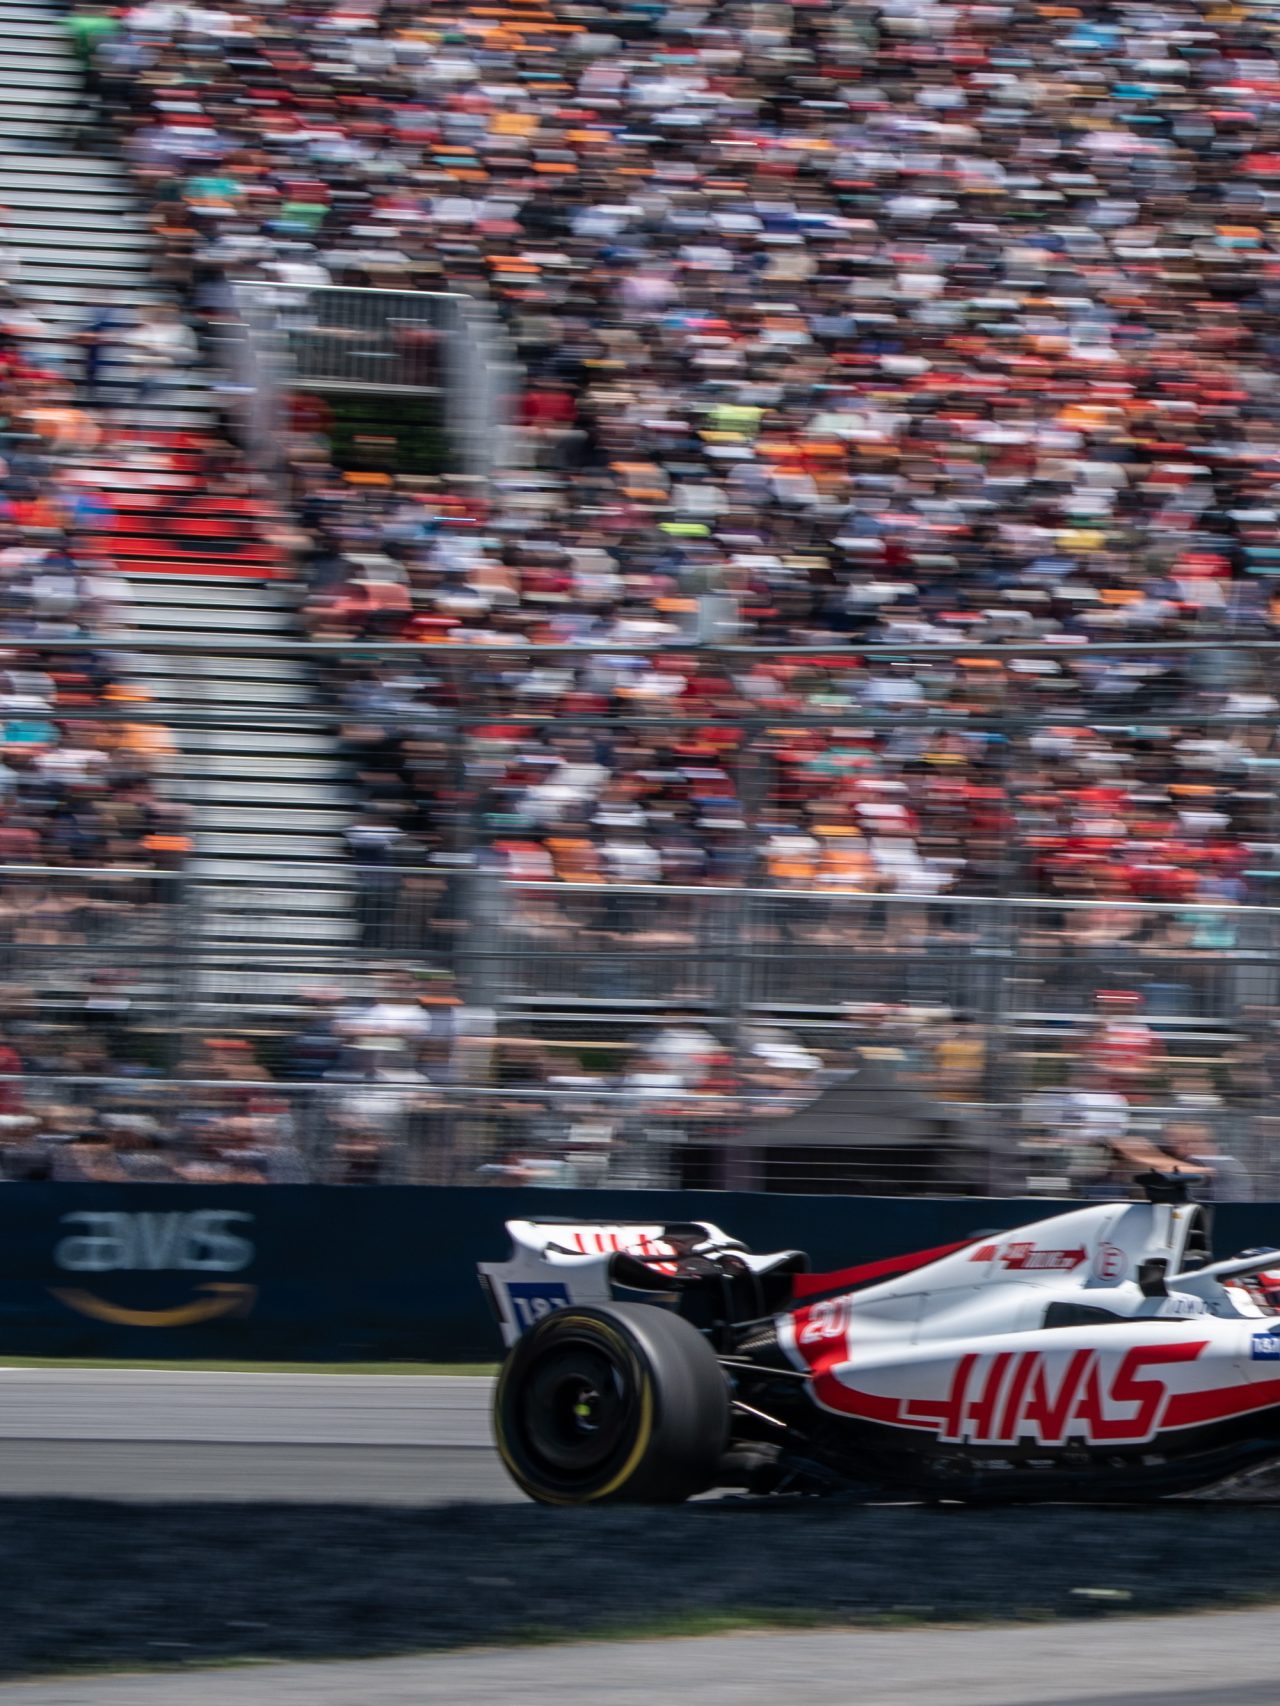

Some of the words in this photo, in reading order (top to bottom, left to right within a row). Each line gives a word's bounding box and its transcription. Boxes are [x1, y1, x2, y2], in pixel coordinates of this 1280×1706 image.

[54, 1209, 255, 1272] aws
[799, 1296, 852, 1344] 20
[910, 1341, 1211, 1443] HAAS
